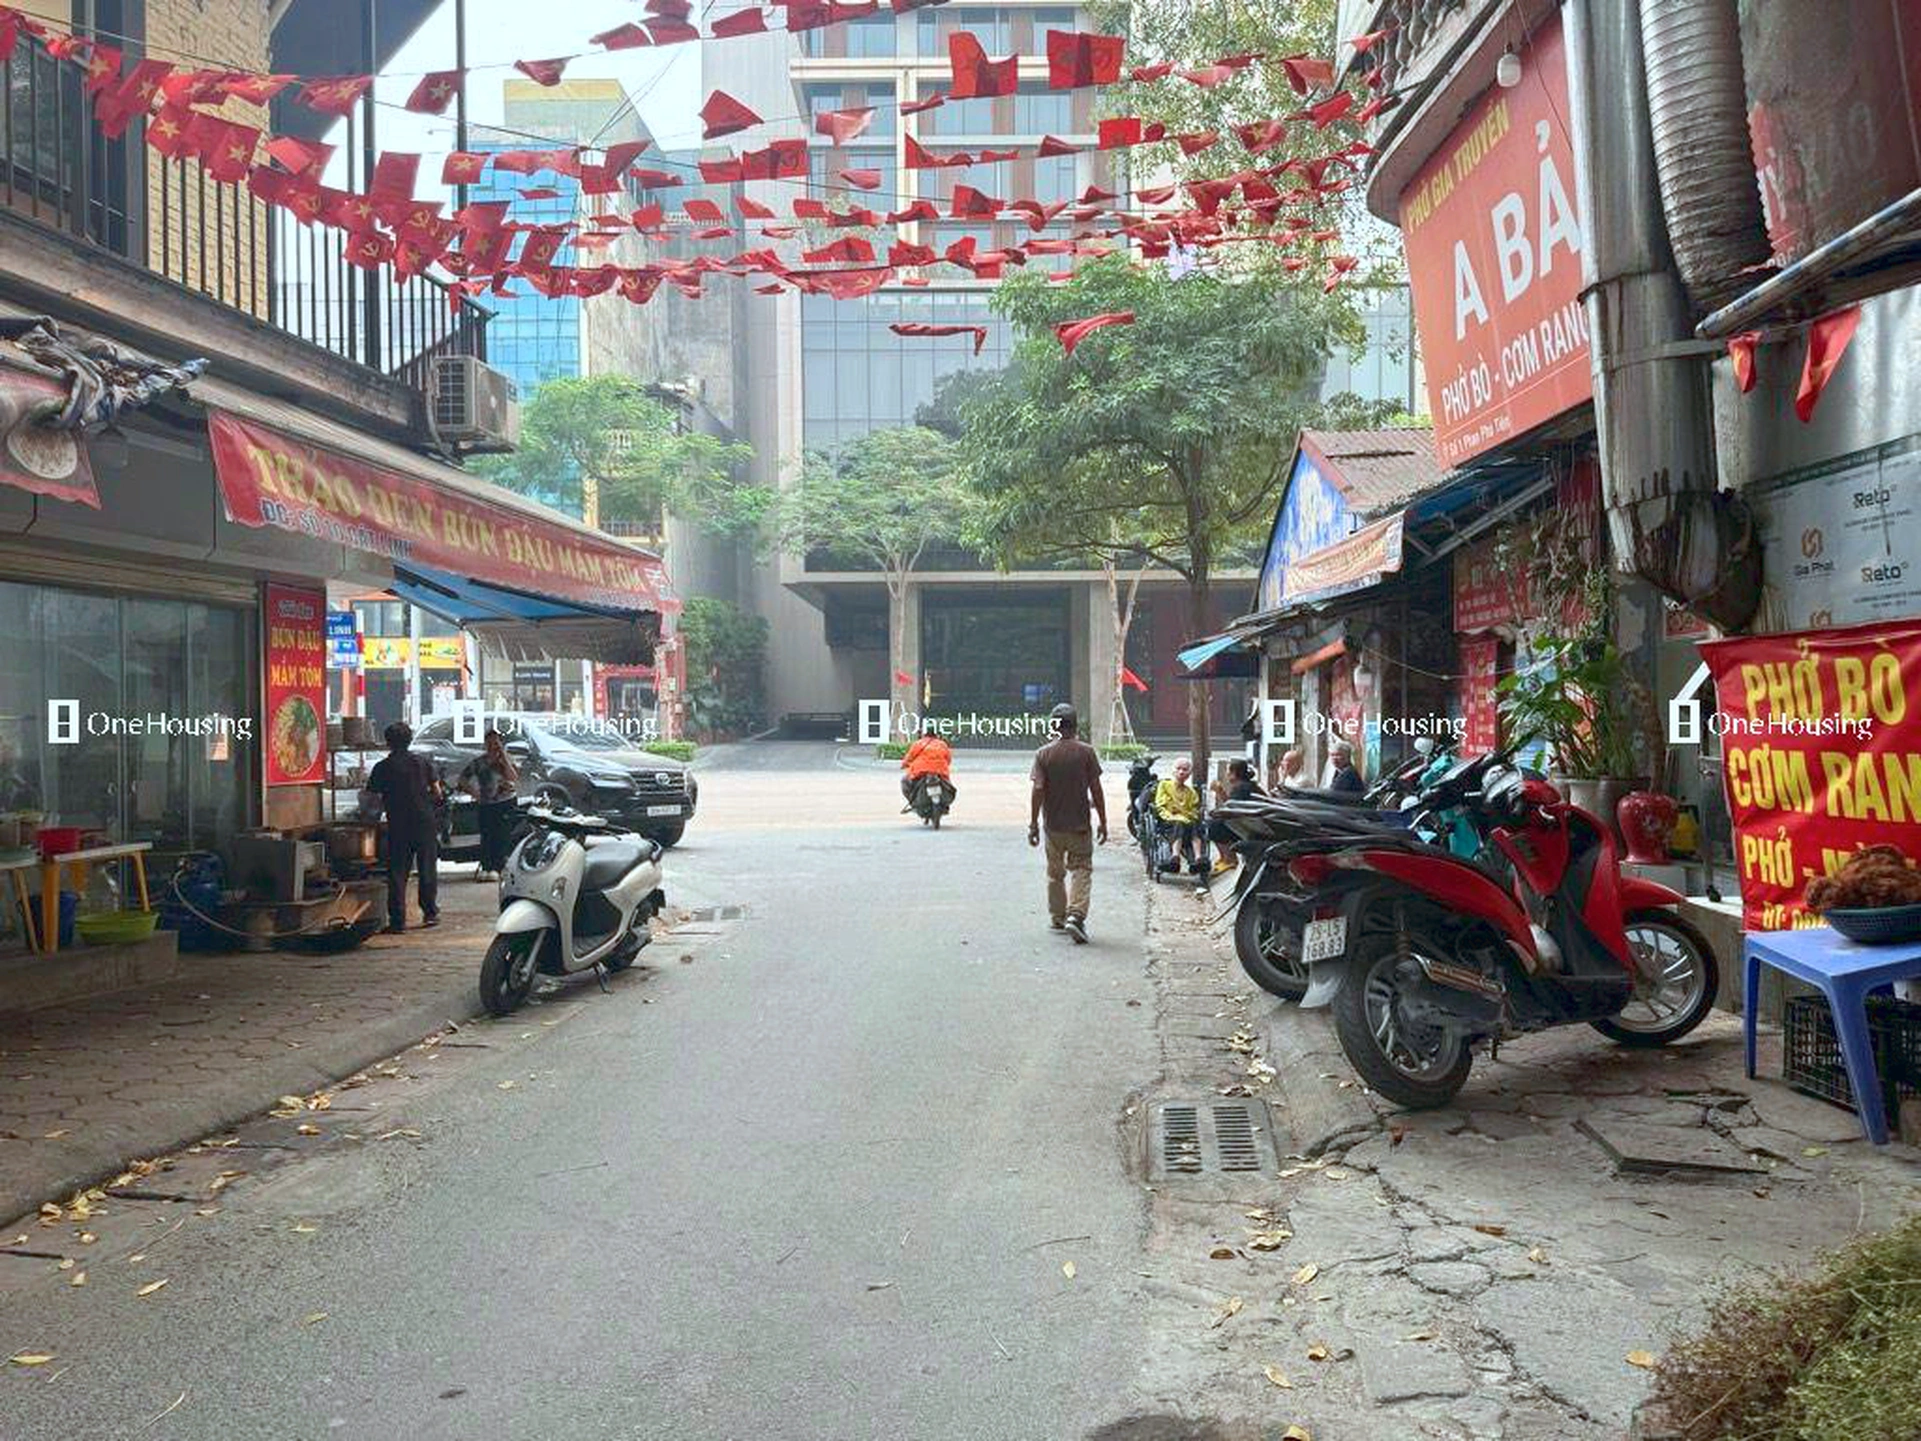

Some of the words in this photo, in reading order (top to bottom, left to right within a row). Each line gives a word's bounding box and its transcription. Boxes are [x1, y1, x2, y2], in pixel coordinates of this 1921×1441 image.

[1455, 239, 1490, 341] A
[1441, 362, 1470, 425] PHỞ
[1470, 352, 1493, 408] BÒ
[1501, 328, 1541, 389] CƠM
[1834, 638, 1906, 726] BÒ
[1728, 743, 1814, 814] CƠM
[1742, 825, 1794, 889] PHỞ
